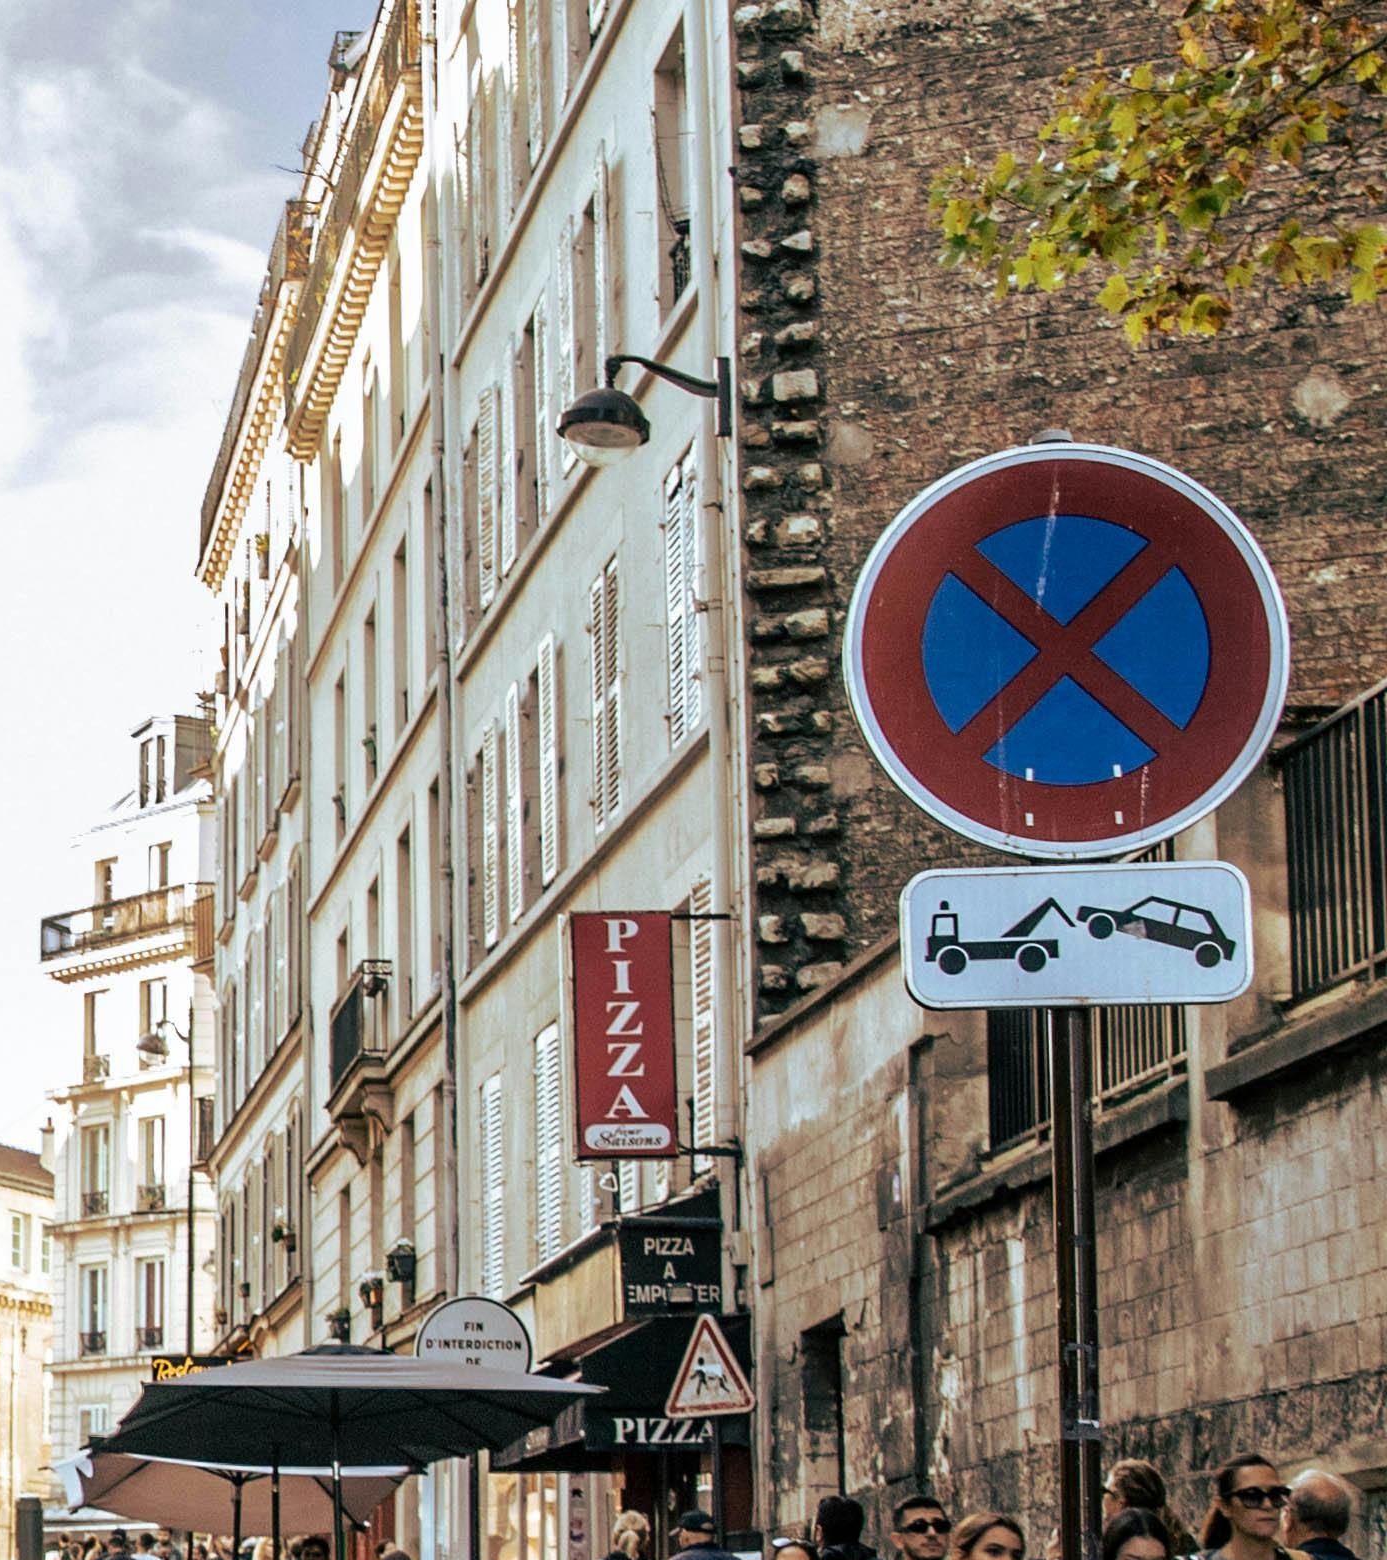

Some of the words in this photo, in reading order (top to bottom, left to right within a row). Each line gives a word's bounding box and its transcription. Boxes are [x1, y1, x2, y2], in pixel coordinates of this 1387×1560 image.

[603, 918, 650, 1119] PIZZA
[643, 1237, 695, 1256] PIZZA
[663, 1261, 677, 1279] A
[627, 1284, 721, 1303] EMPER
[464, 1321, 484, 1332] FIN
[425, 1338, 522, 1351] D'INTERDICTION
[612, 1417, 715, 1444] PIZZA
